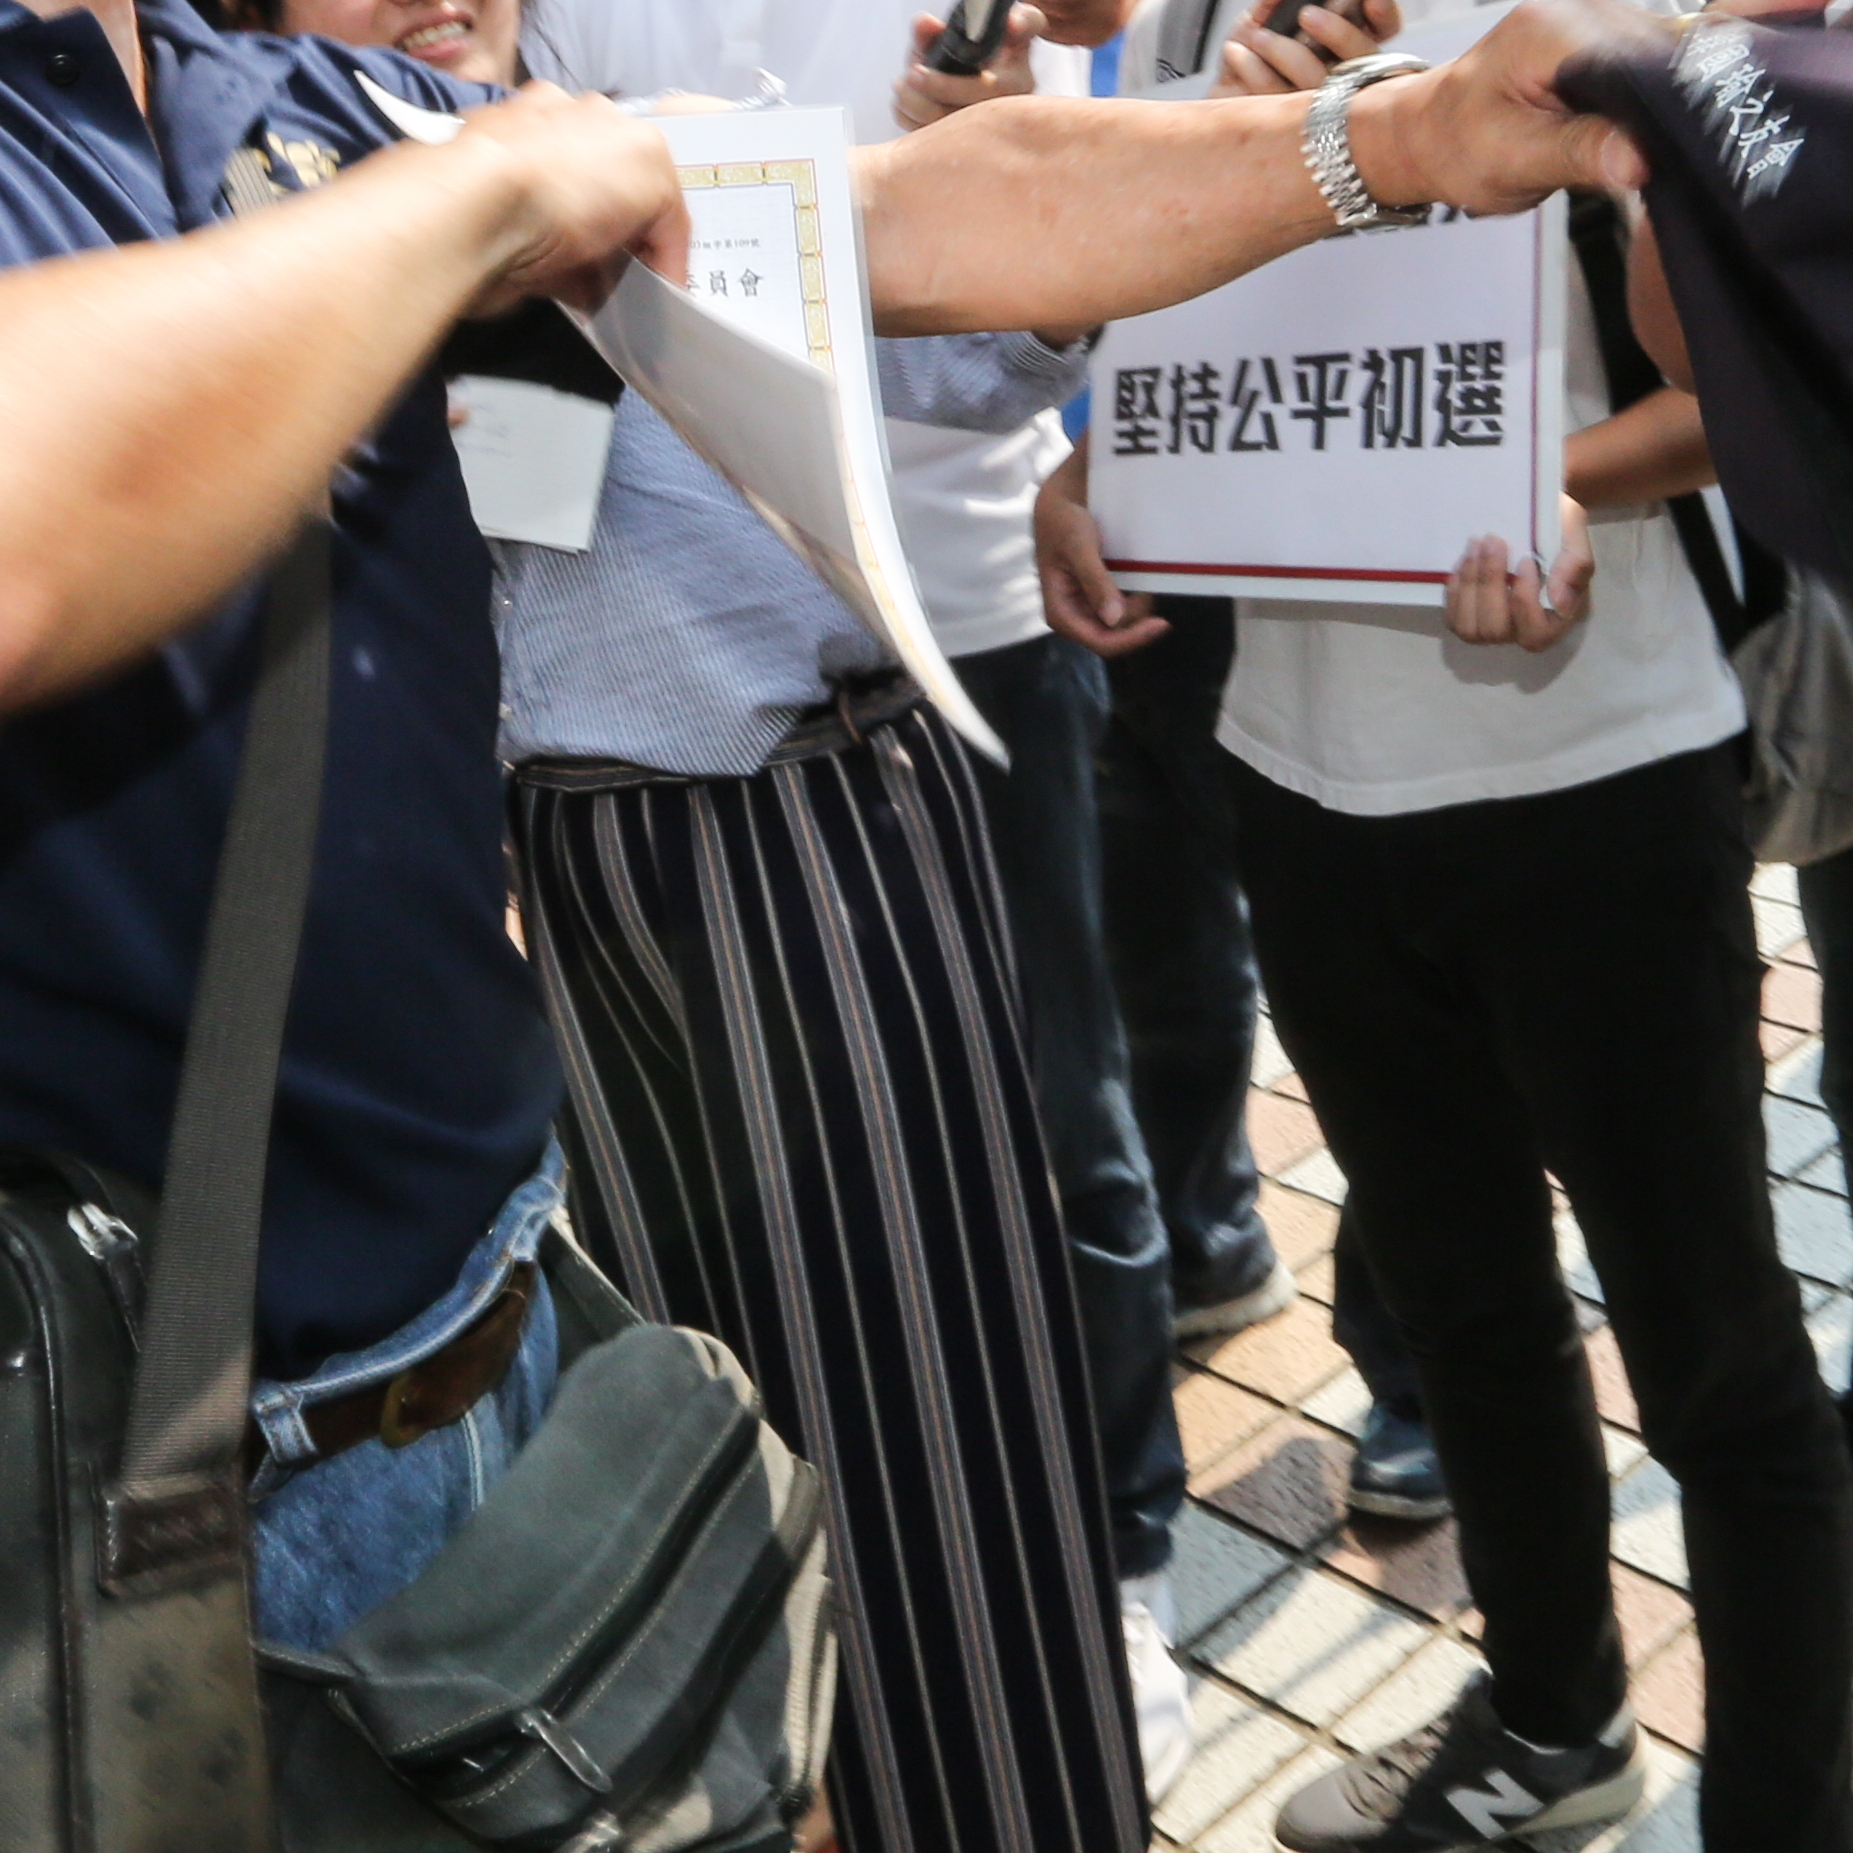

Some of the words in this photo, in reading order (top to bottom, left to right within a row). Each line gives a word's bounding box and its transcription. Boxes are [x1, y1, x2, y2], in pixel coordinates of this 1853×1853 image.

[1112, 340, 1504, 456] 堅持公平初選
